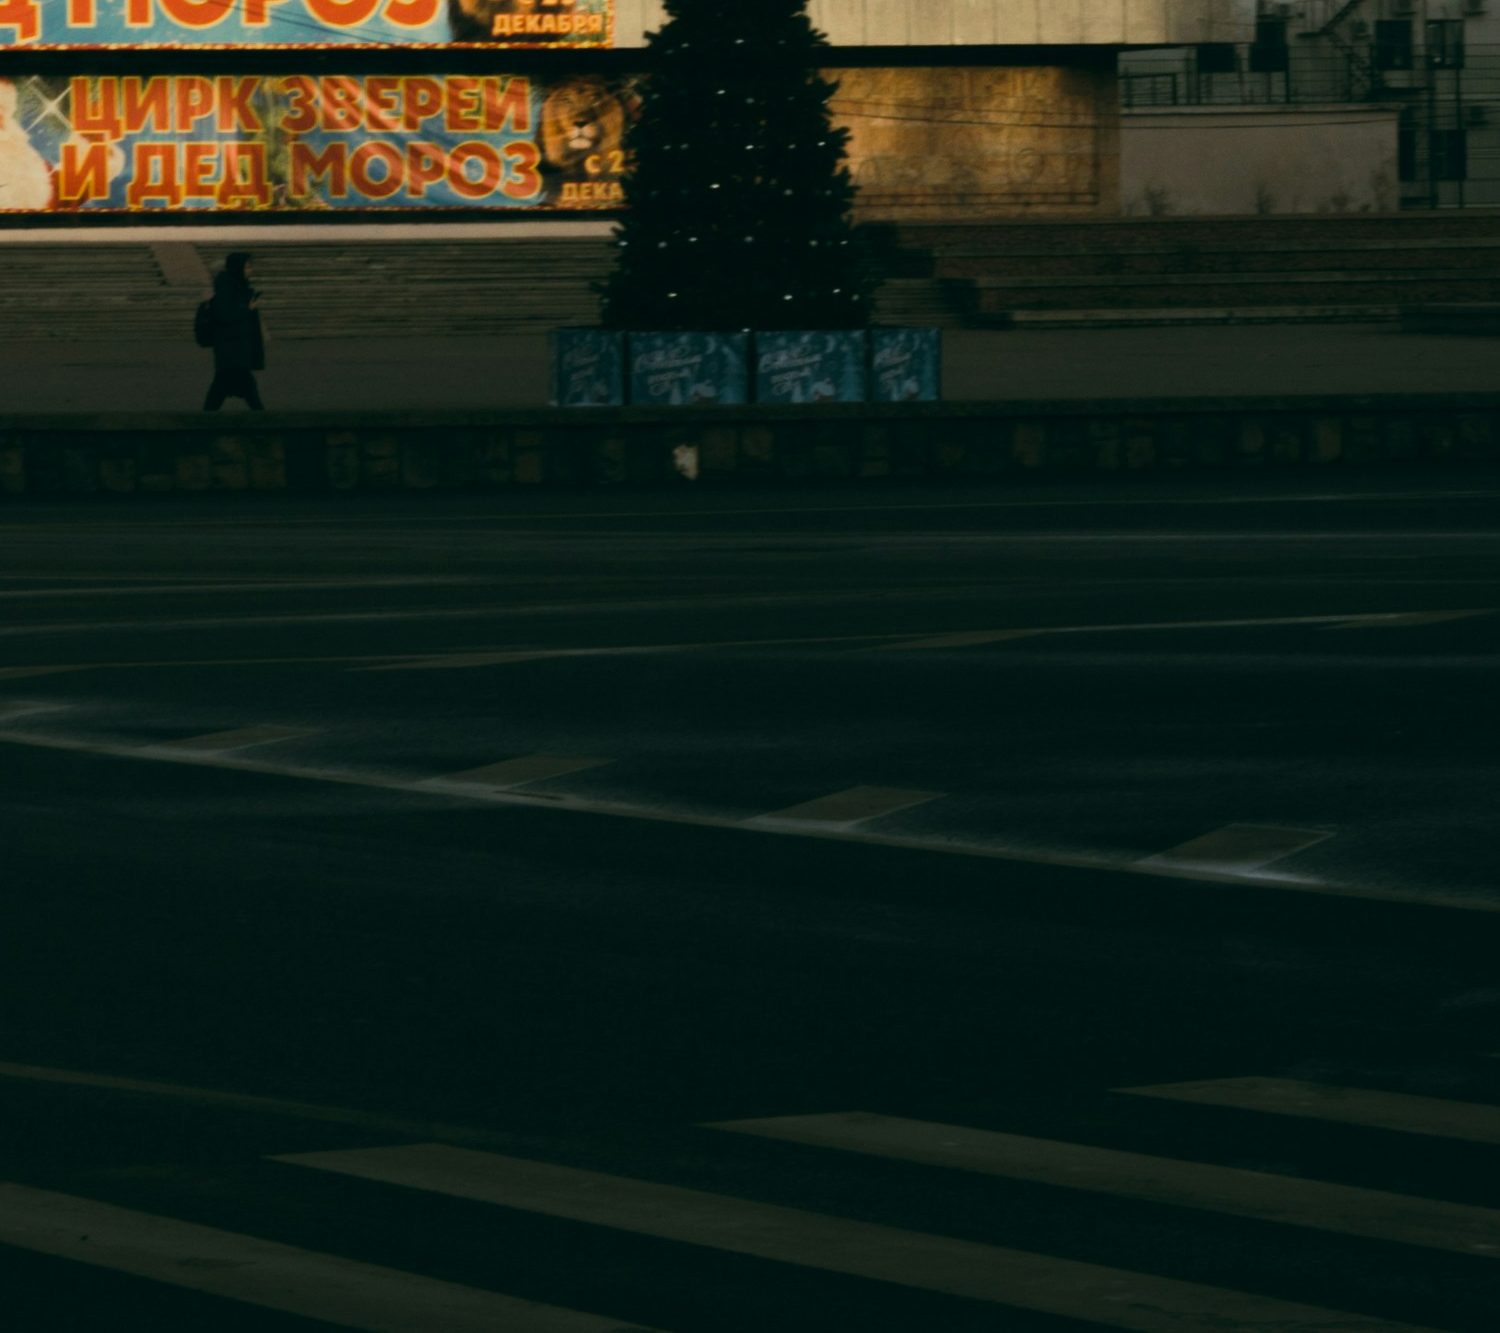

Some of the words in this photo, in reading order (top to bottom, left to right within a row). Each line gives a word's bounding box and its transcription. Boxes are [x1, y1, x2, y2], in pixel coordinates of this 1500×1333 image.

[491, 13, 604, 37] ДЕКАБРЯ
[69, 74, 262, 141] ЦИРК
[59, 142, 112, 201] И
[126, 141, 270, 208] ДЕД
[287, 140, 545, 200] МОРОЗ
